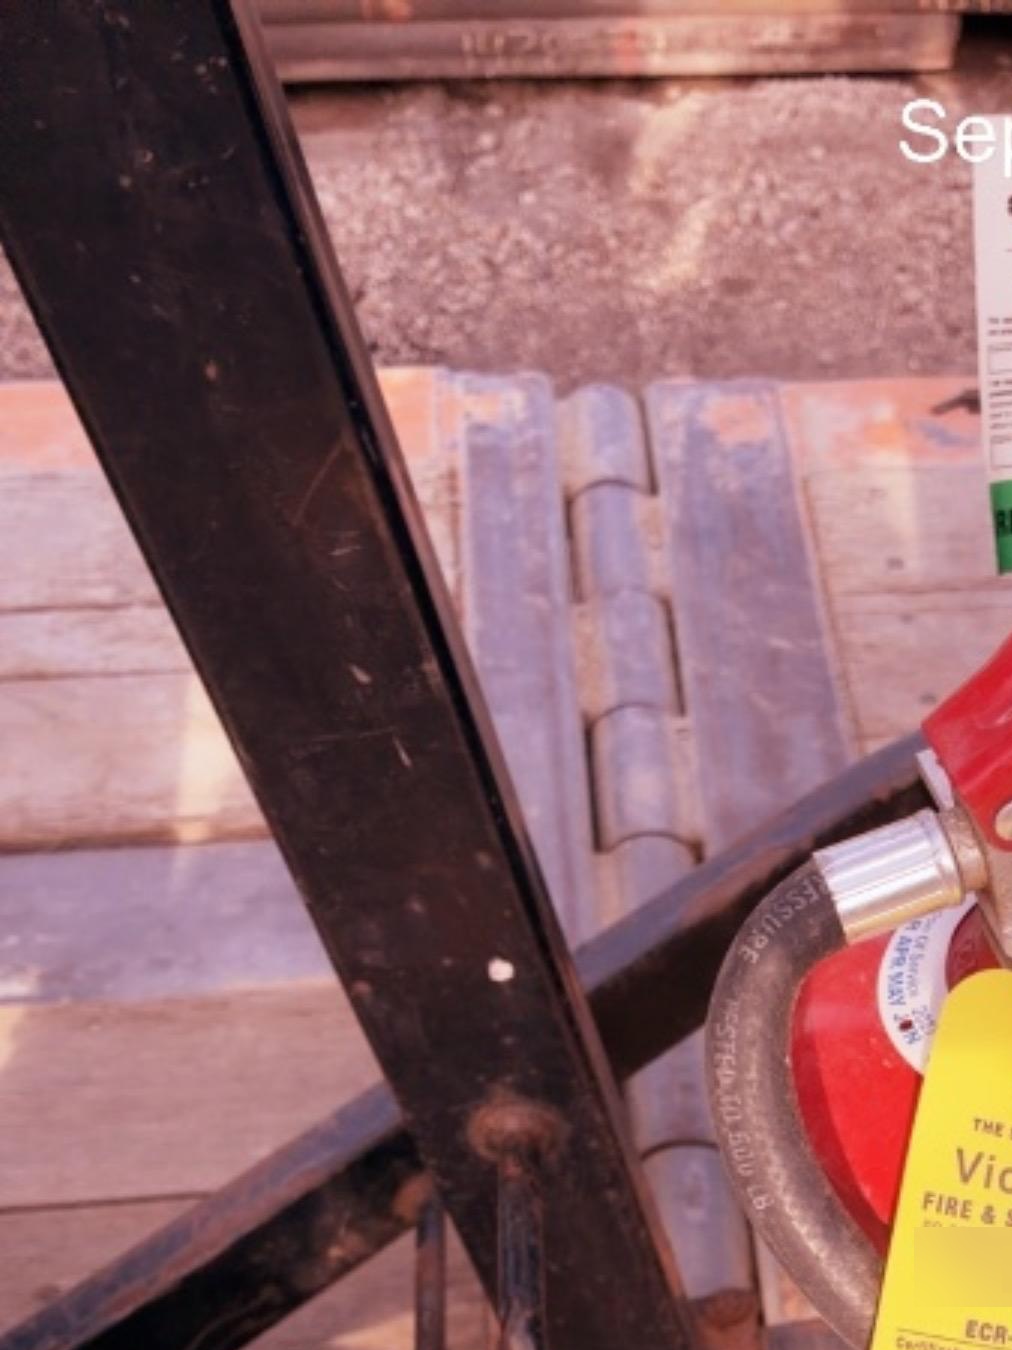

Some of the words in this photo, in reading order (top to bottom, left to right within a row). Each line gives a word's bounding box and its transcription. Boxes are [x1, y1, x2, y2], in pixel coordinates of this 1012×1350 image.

[890, 935, 912, 967] APR
[888, 971, 907, 1006] MAY
[973, 1118, 1003, 1137] THE
[922, 1191, 973, 1220] FIRE
[981, 1205, 996, 1226] &
